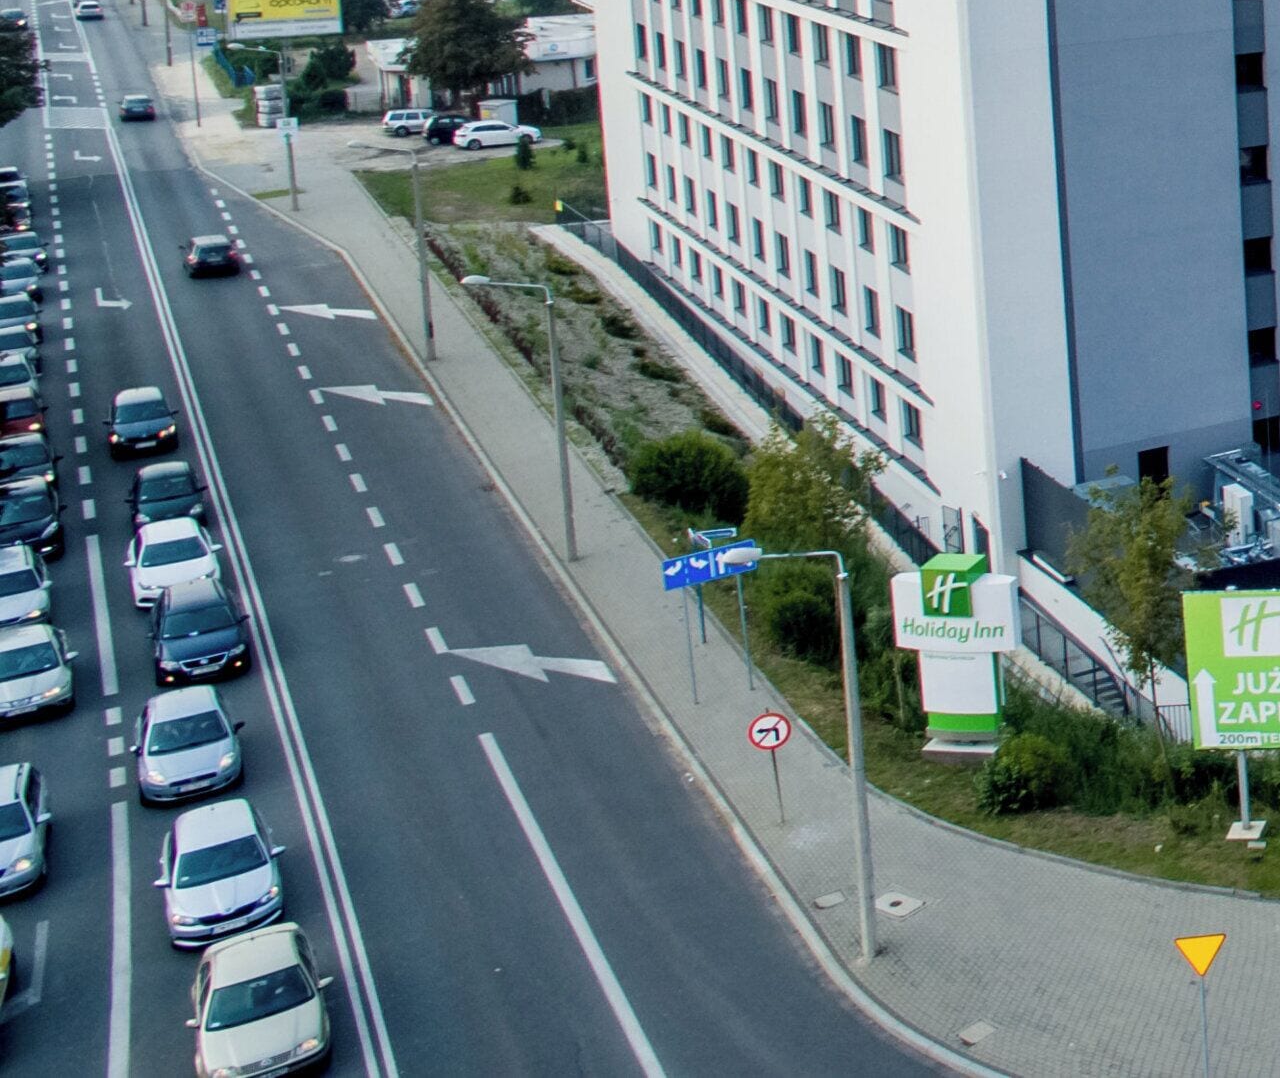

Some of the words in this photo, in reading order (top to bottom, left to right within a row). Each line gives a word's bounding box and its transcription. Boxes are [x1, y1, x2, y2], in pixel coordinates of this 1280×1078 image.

[902, 617, 971, 643] Holiday
[973, 620, 1005, 639] Inn
[1219, 734, 1258, 745] 200m
